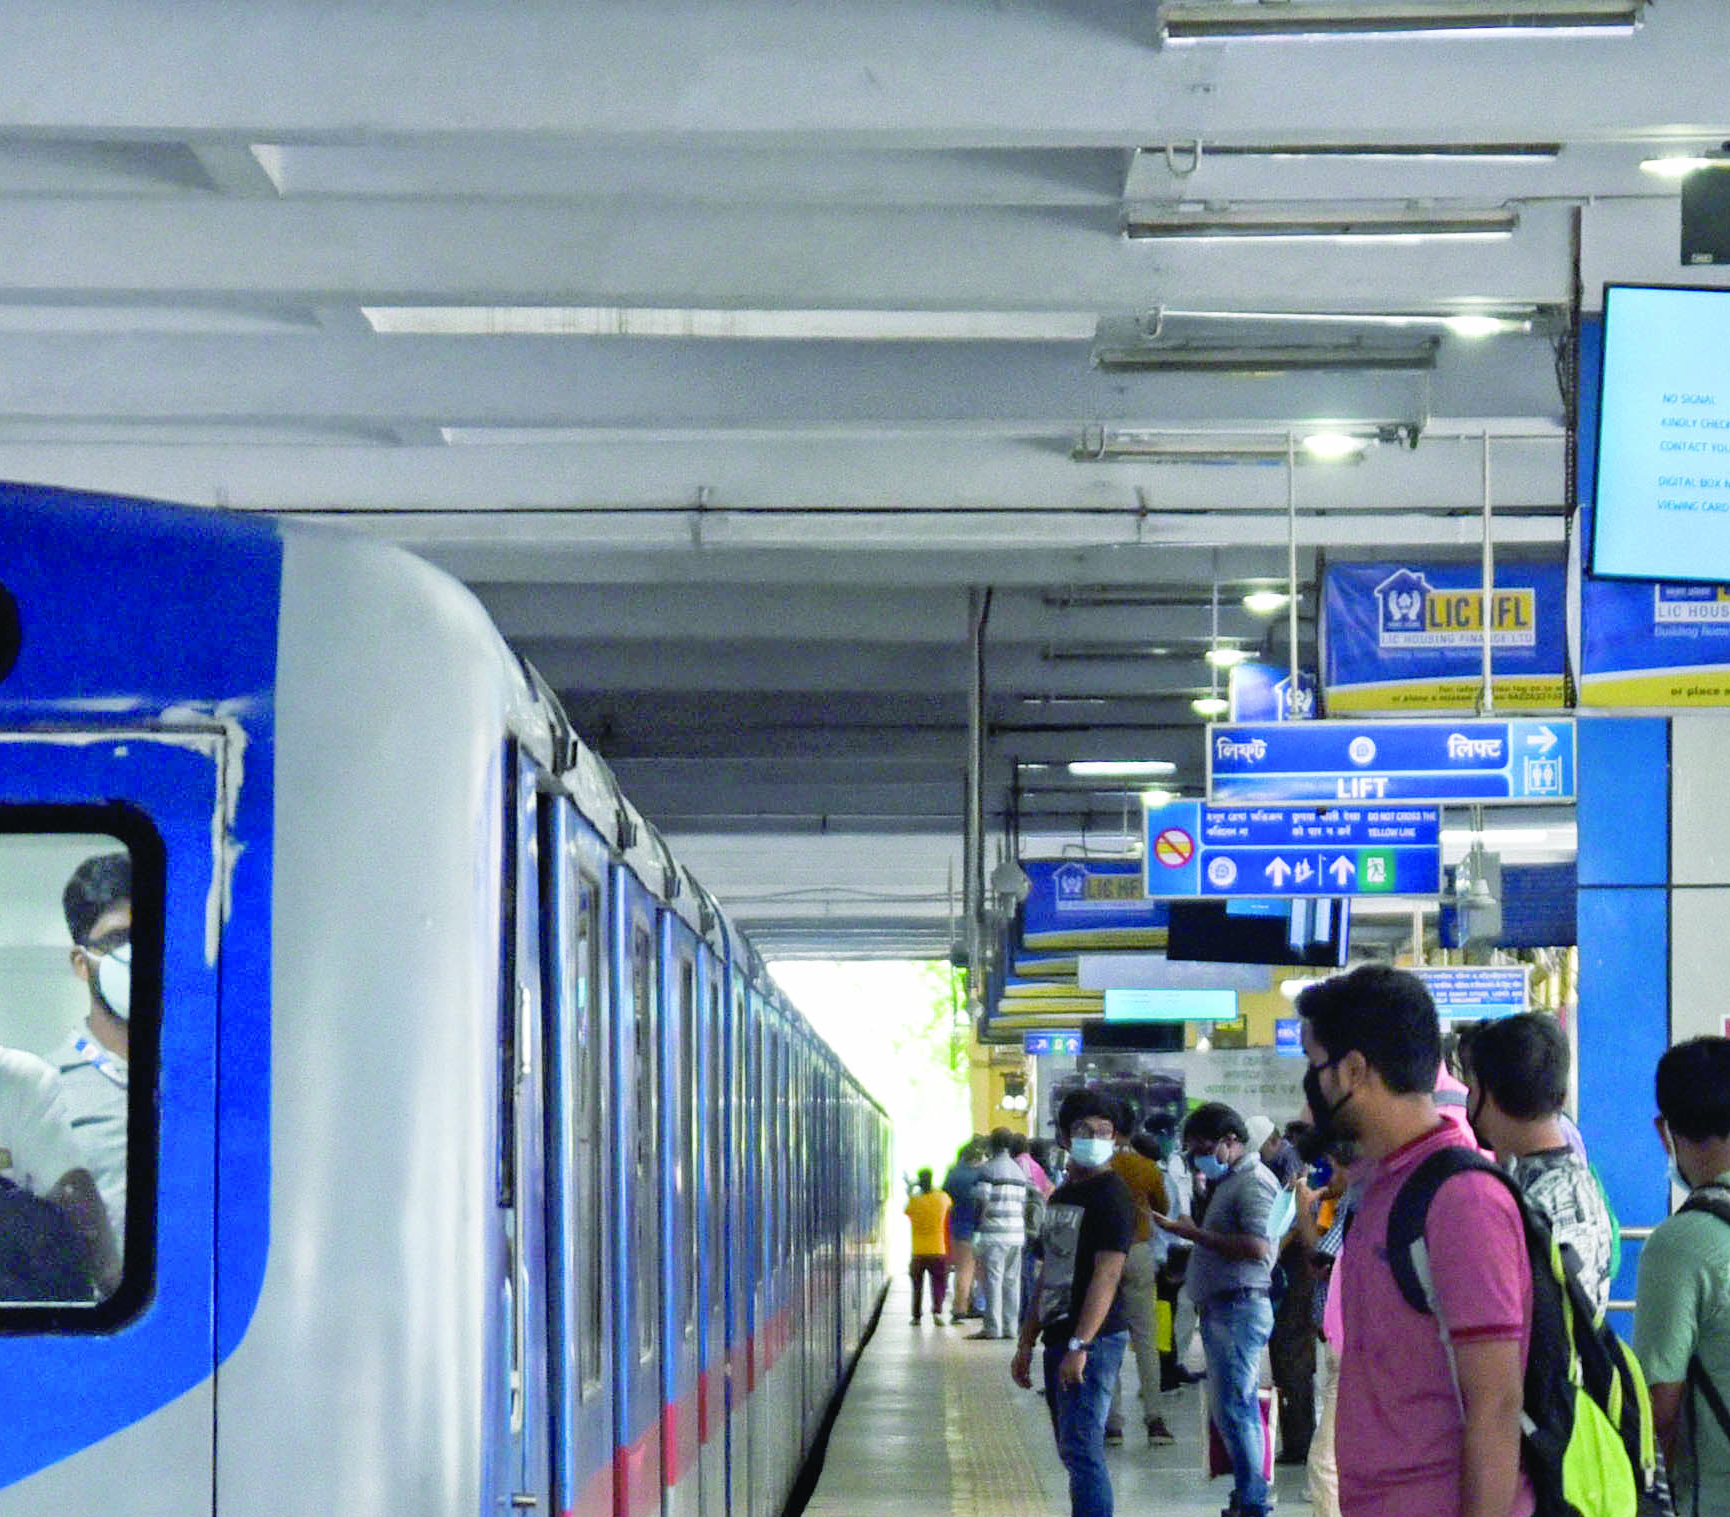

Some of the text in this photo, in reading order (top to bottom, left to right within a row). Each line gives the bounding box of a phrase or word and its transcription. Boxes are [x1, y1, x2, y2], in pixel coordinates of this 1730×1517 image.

[1660, 441, 1708, 453] CONTACT
[1430, 598, 1469, 627] LIC
[1658, 603, 1682, 618] LIC
[1337, 777, 1389, 800] LIFT
[1380, 812, 1395, 822] NOT
[1422, 811, 1437, 822] THE
[1368, 827, 1398, 837] YELLOW
